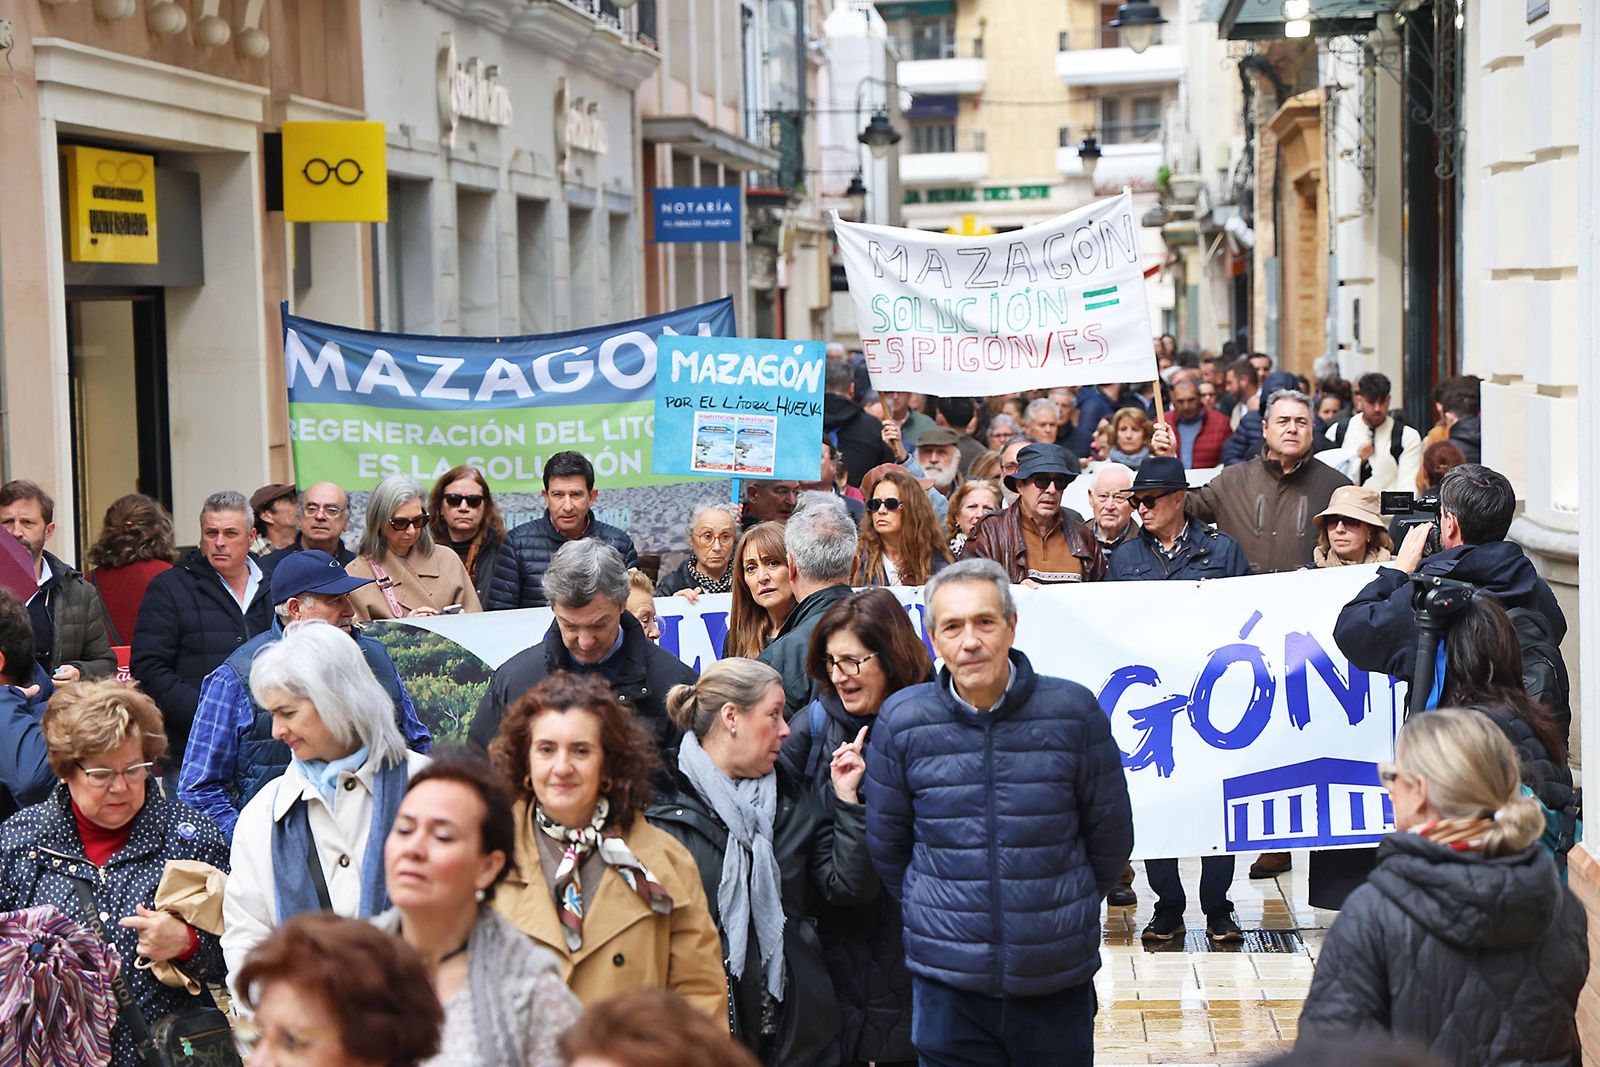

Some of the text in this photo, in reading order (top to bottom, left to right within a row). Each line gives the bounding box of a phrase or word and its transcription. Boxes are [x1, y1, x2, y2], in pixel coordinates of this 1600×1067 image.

[661, 199, 733, 215] NOTARÍA
[868, 215, 1137, 289] MAZAGÓN
[872, 286, 1068, 334] SOLUCIÓN
[284, 323, 713, 401] MAZAGO
[671, 344, 823, 393] MAZAGÓN
[665, 396, 693, 409] POR
[700, 396, 716, 409] EL
[536, 418, 595, 445] DEL
[359, 453, 401, 479] ES
[411, 455, 452, 480] LA
[1096, 610, 1371, 778] GÓN
[113, 977, 133, 1007] TOU
